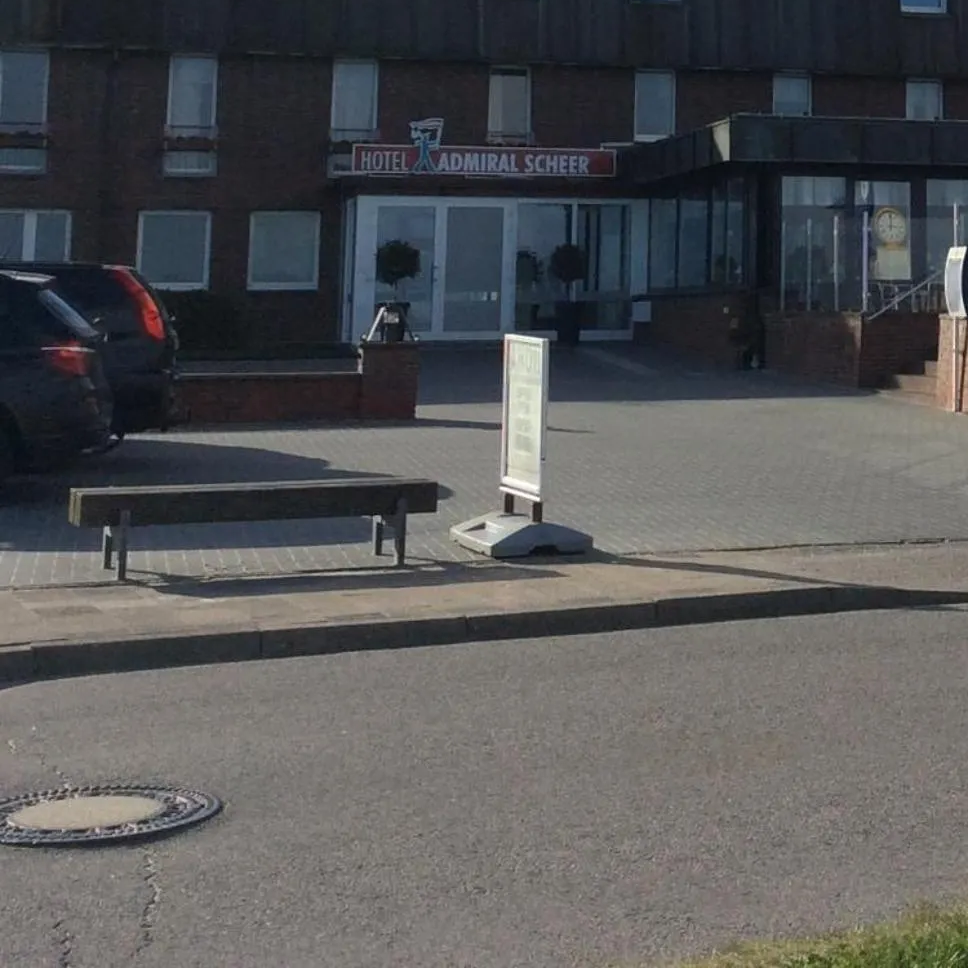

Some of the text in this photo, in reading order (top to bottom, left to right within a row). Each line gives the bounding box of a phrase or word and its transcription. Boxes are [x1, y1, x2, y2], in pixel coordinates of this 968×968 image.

[361, 150, 589, 174] HOTEL ADMIRAL SCHEER
